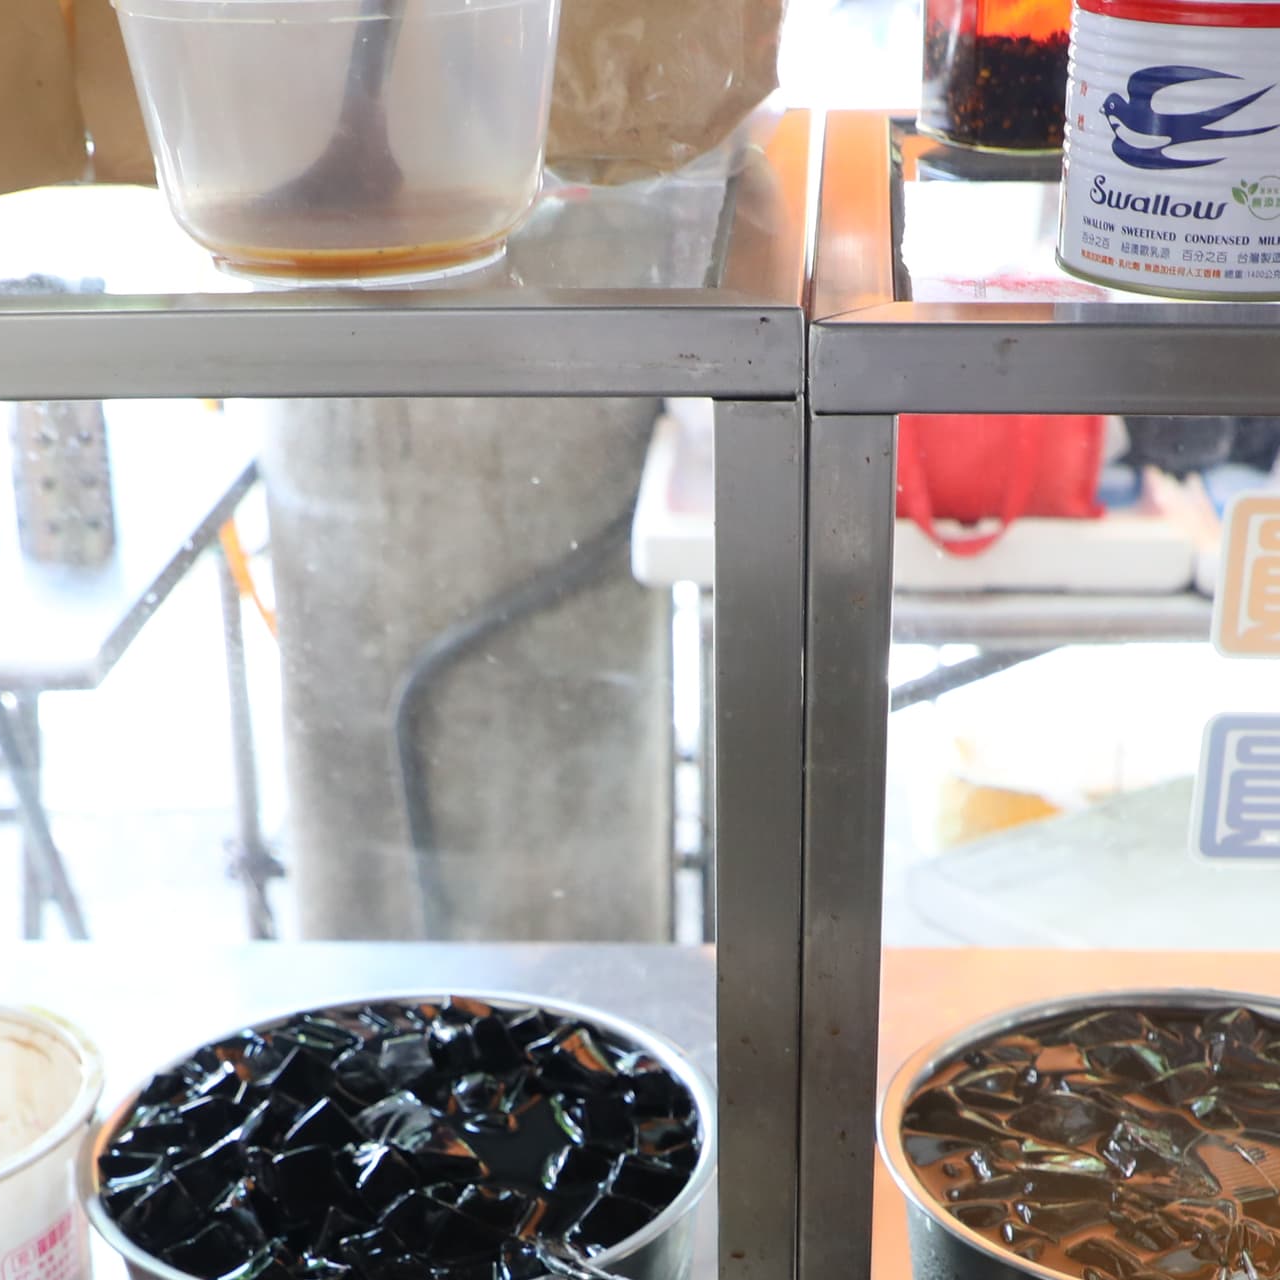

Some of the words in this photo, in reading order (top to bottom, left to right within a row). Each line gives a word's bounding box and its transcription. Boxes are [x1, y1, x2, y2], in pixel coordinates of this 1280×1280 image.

[1089, 174, 1229, 221] Swallow
[1082, 215, 1115, 233] SWALLOW
[1121, 225, 1177, 242] SWEETENED
[1184, 232, 1250, 246] CONDENSED
[1182, 249, 1228, 264] 百分之百
